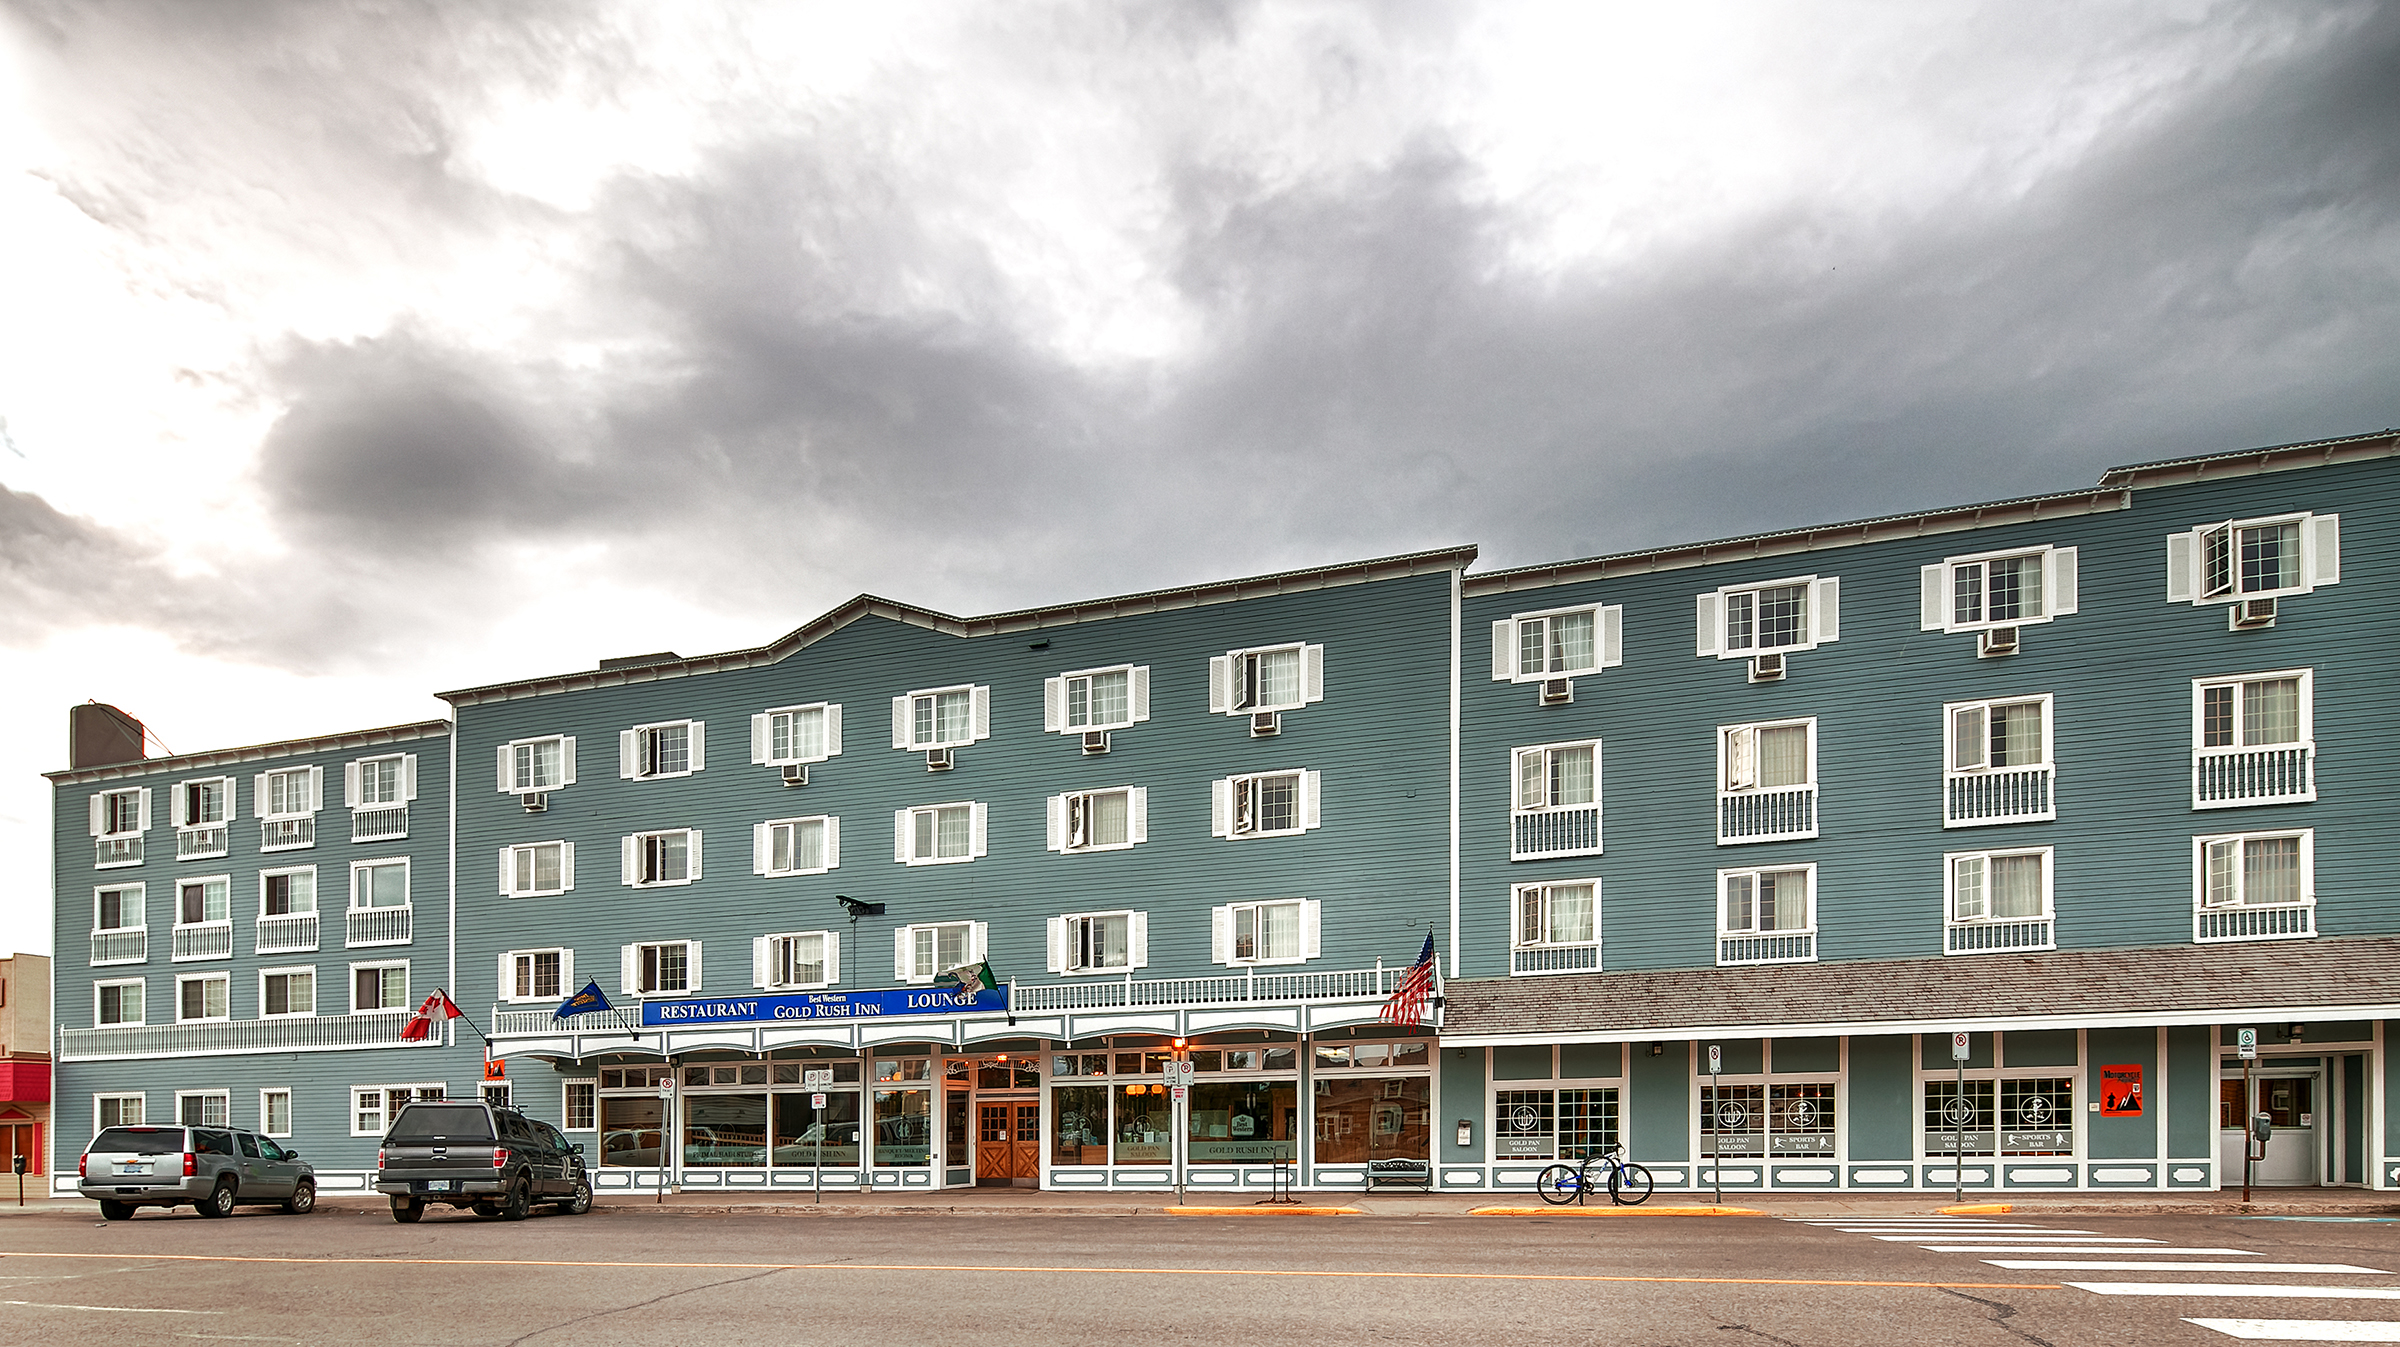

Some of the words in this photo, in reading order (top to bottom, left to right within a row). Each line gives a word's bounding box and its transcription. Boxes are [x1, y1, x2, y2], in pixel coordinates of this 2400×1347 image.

[808, 994, 822, 1003] Best
[822, 994, 847, 1003] Western
[907, 992, 978, 1008] LOUNGE
[660, 1002, 758, 1019] RESTAURANT
[774, 1005, 812, 1019] GOLD
[815, 1004, 850, 1017] RUSH
[854, 1002, 881, 1015] INN
